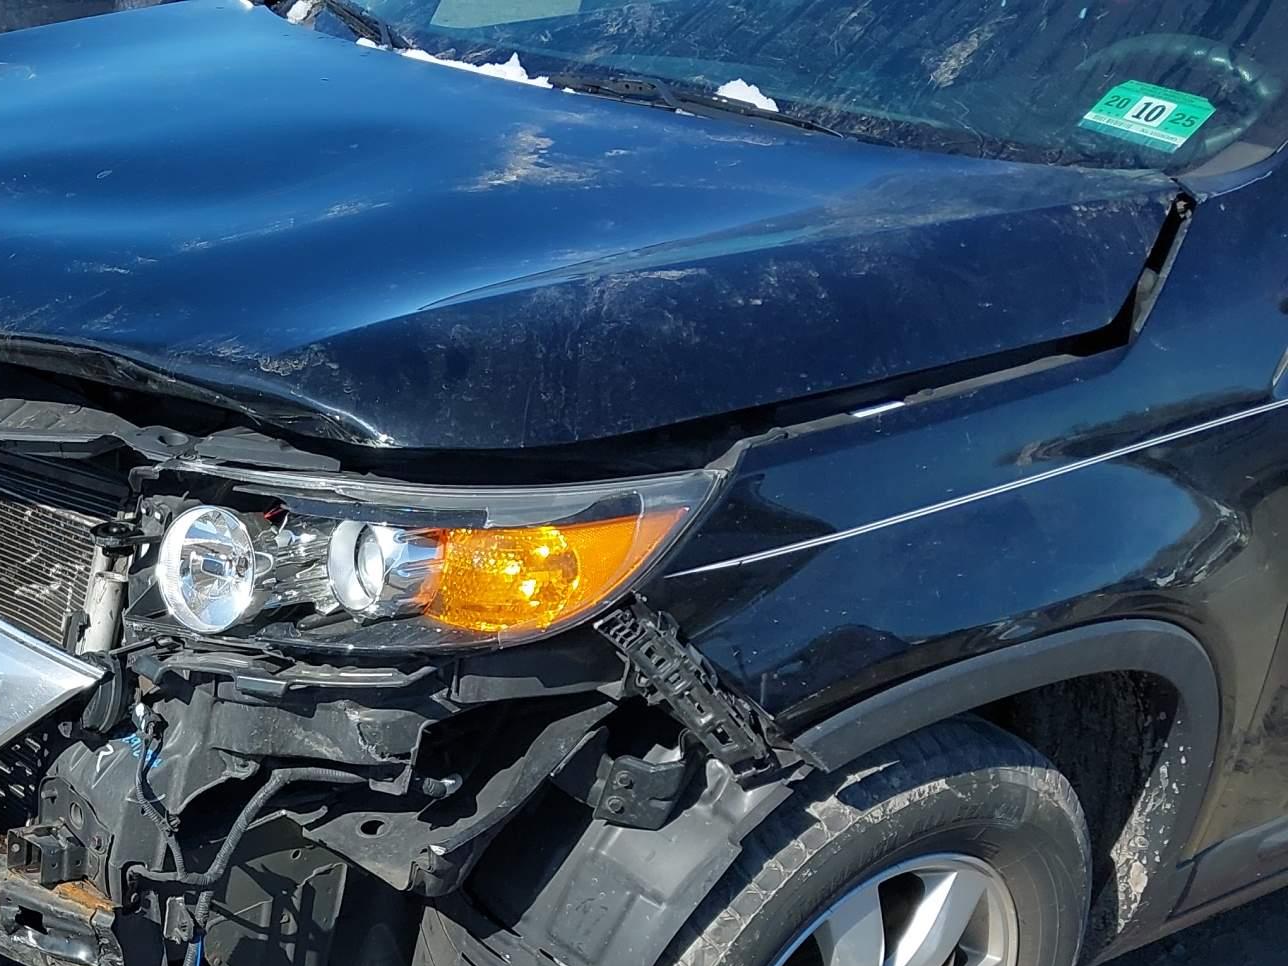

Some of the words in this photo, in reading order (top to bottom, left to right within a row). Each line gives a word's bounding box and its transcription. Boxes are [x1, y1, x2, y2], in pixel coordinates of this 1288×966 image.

[1103, 95, 1132, 110] 20
[1131, 101, 1167, 123] 10
[1168, 112, 1200, 128] 25
